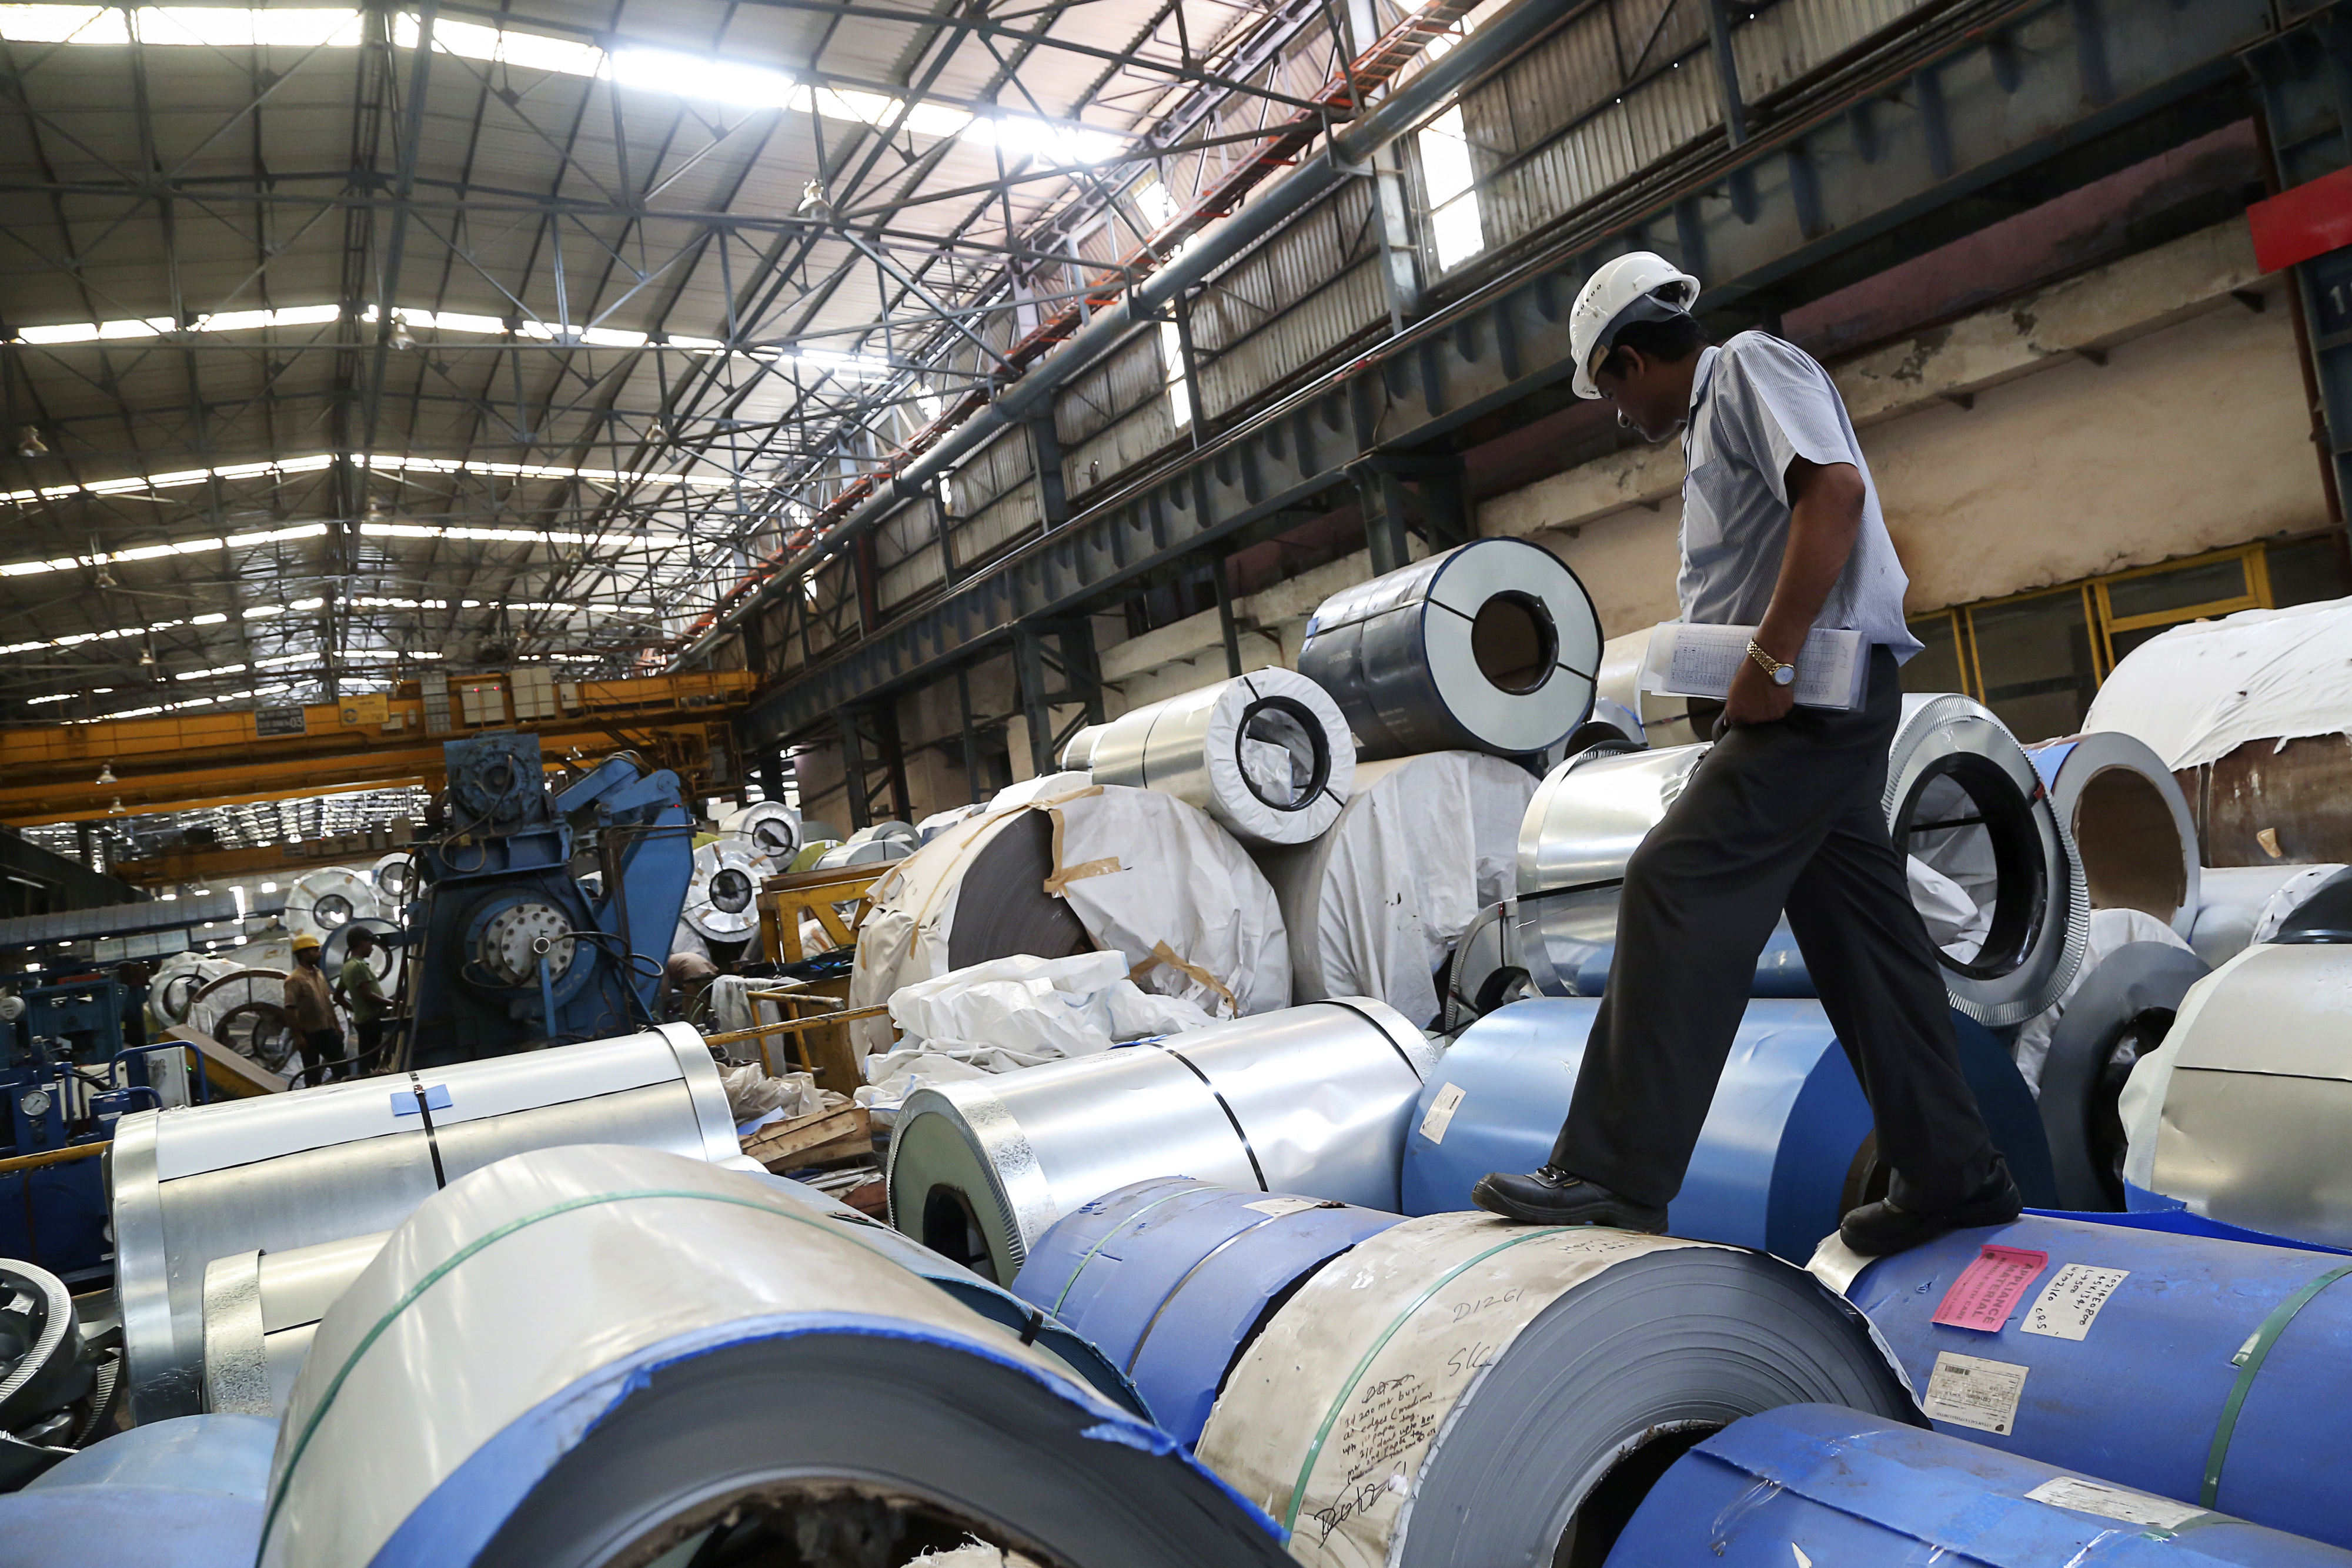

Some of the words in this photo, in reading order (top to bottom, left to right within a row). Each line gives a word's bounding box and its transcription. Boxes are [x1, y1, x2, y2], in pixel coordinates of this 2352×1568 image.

[2329, 281, 2352, 315] 1
[1982, 1257, 2007, 1281] HANDLE
[1972, 1281, 1986, 1299] WITH
[1972, 1265, 2019, 1318] MATERIAL
[1982, 1263, 2033, 1324] APPLIANCE
[1956, 1300, 1972, 1320] CARE
